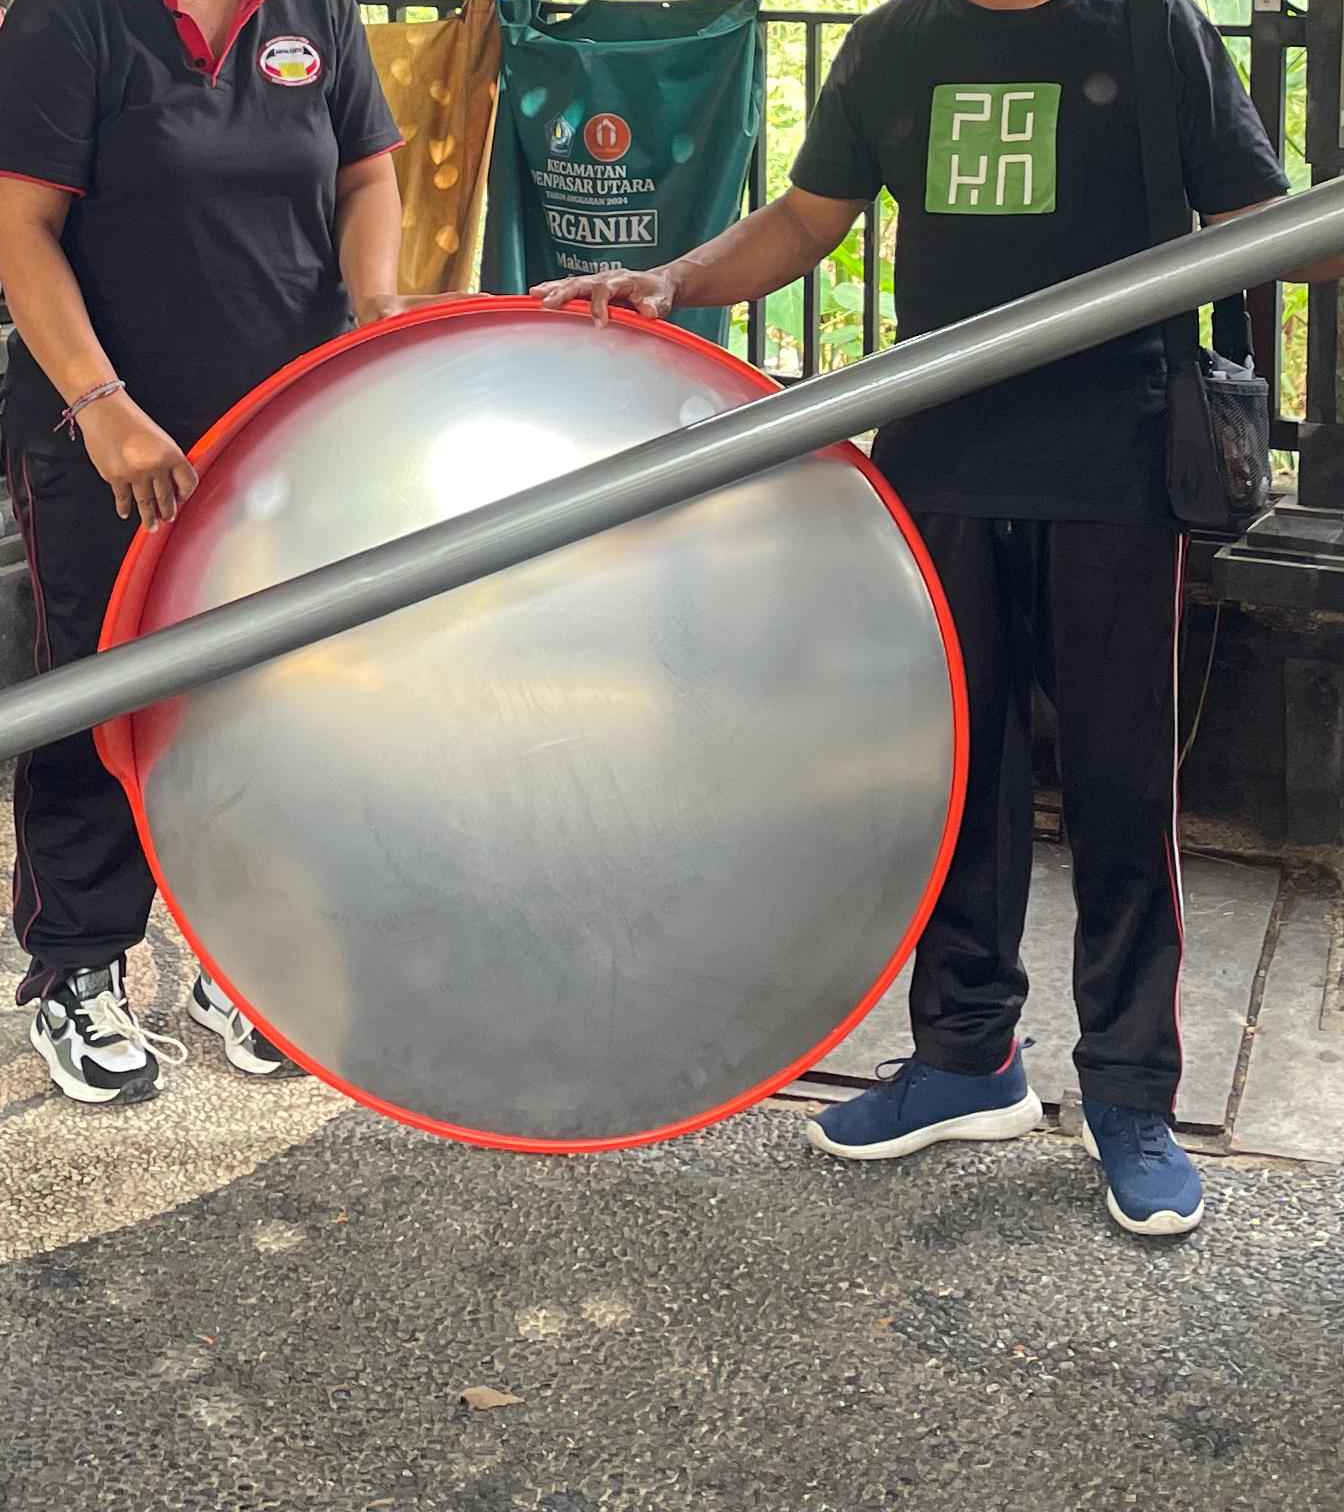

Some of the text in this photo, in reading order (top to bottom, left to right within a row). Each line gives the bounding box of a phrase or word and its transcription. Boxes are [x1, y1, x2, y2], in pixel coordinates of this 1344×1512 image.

[546, 158, 628, 179] KECAMATAN
[596, 178, 656, 195] UTARA
[546, 211, 653, 242] RGANIK
